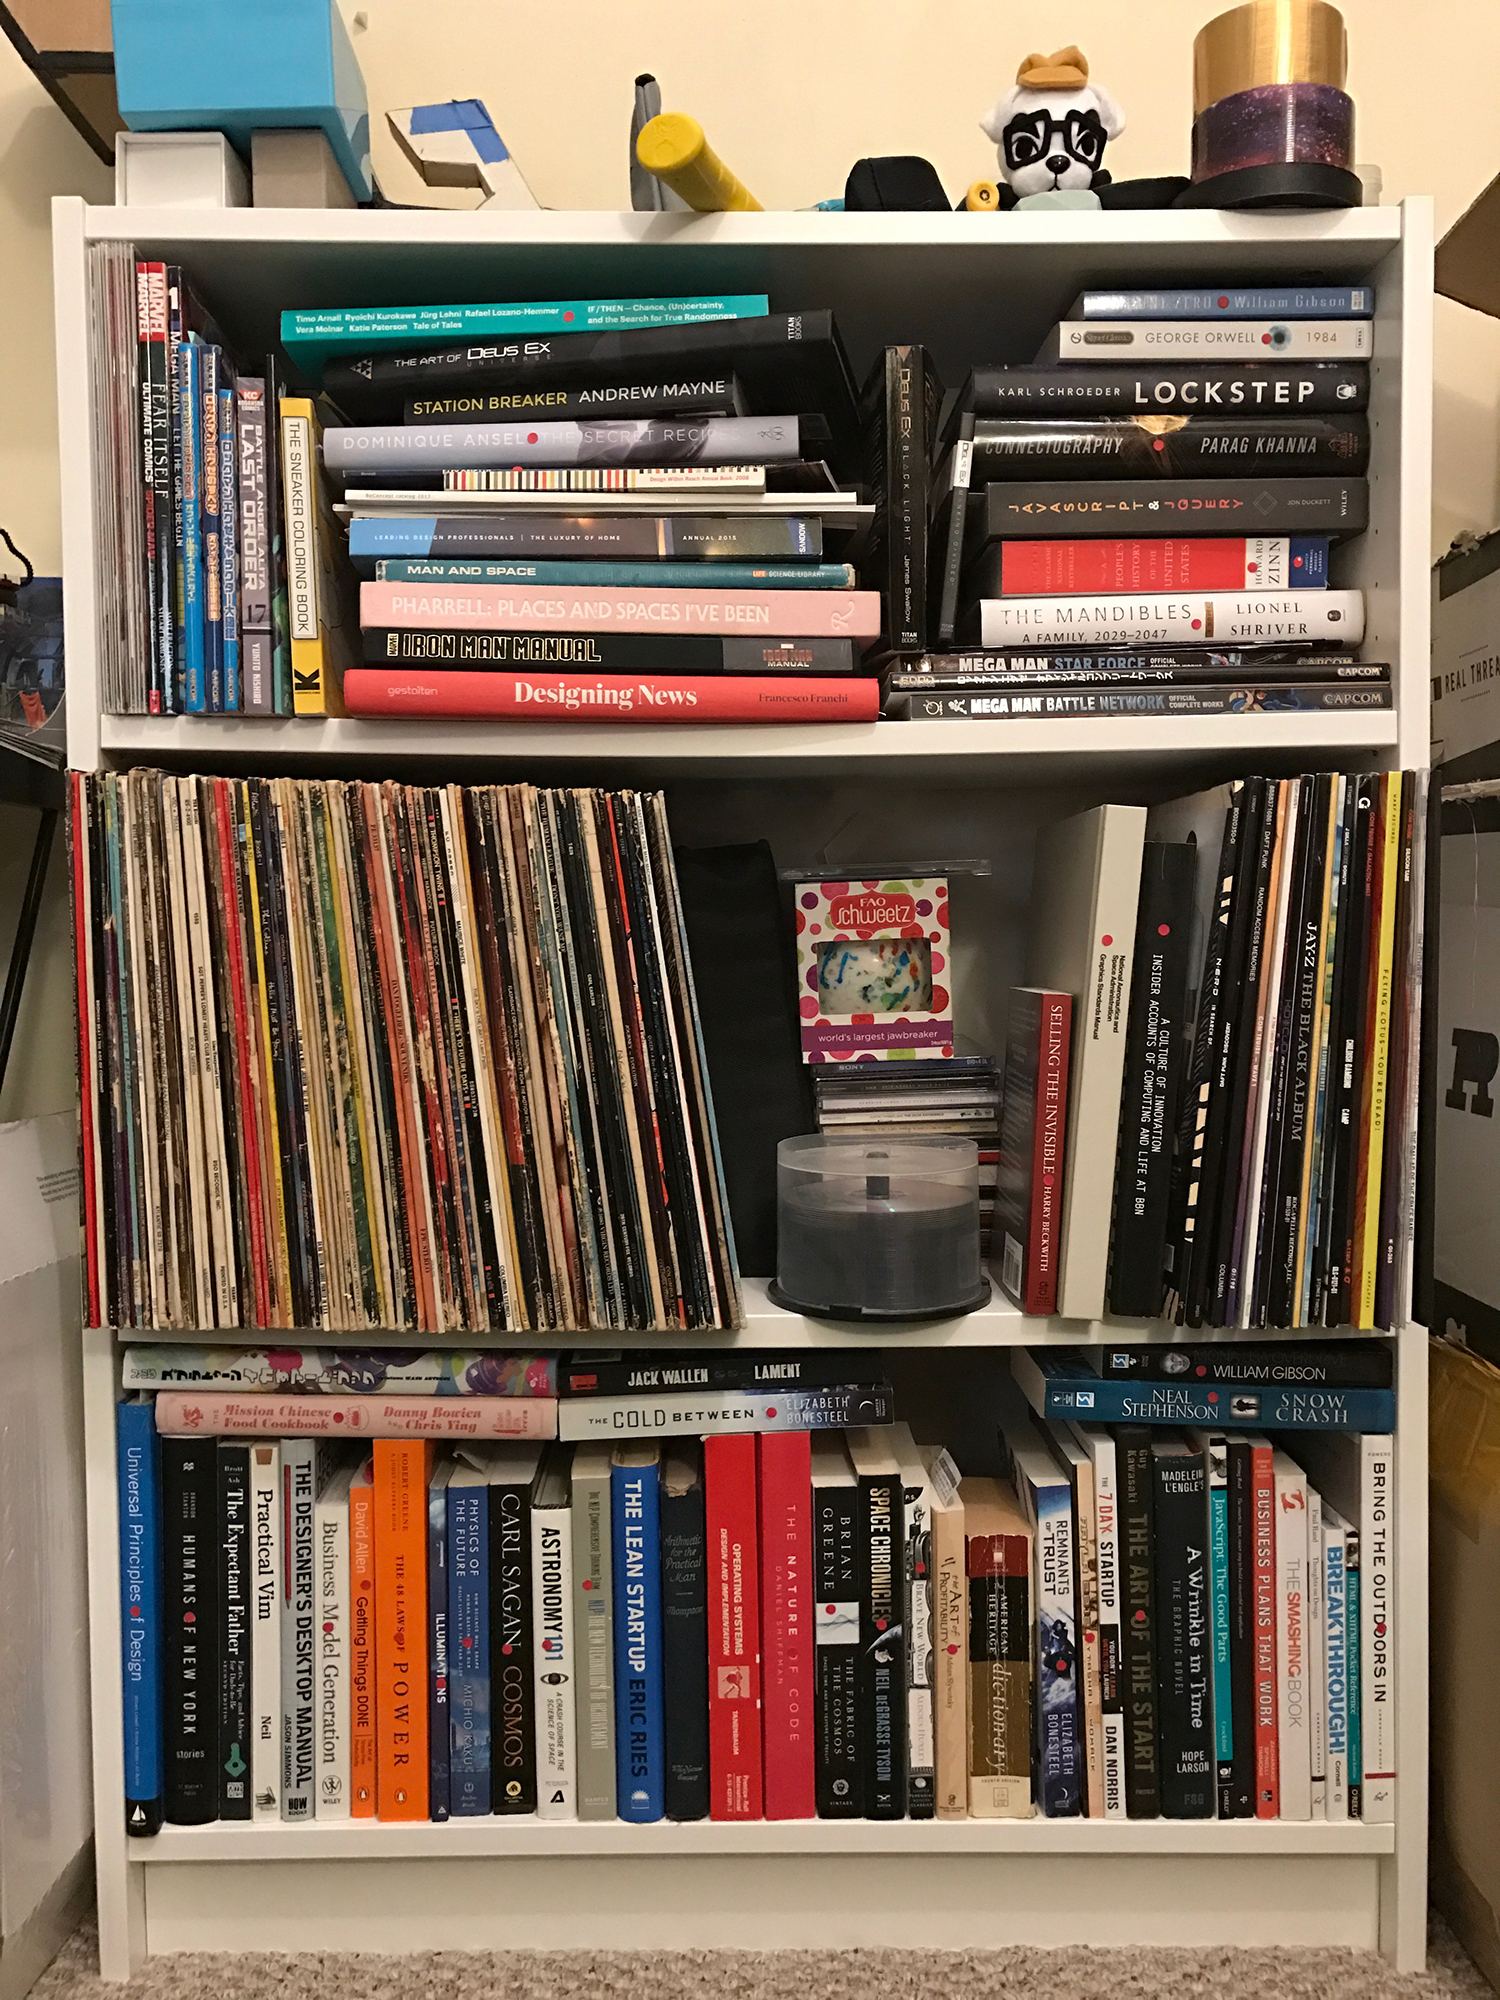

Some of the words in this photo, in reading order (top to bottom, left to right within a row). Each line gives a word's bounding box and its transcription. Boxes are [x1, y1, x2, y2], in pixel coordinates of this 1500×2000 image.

[296, 315, 315, 323] Timo
[318, 314, 341, 322] Arnall
[345, 313, 374, 322] Ryoichi
[376, 312, 416, 320] Kurokawa
[442, 310, 461, 318] Lehni
[465, 309, 490, 317] Rafael
[492, 307, 559, 317] Lozano-Hemmer
[395, 358, 418, 367] THE
[422, 356, 443, 365] ART
[447, 355, 461, 363] OF
[524, 342, 550, 356] EX
[1146, 332, 1199, 344] GEORGE
[1206, 332, 1255, 343] ORWELL
[1306, 332, 1337, 343] 1984
[413, 396, 481, 414] STATION
[489, 393, 567, 411] BREAKER
[579, 385, 656, 403] ANDREW
[663, 381, 725, 397] MAYNE
[998, 388, 1031, 397] KARL
[1039, 387, 1120, 397] SCHROEDER
[1135, 382, 1315, 403] LOCKSTEP
[289, 422, 300, 448] THE
[344, 434, 452, 449] DOMINIQUE
[464, 433, 524, 446] ANSEL
[1201, 438, 1252, 454] PARAG
[1256, 437, 1316, 454] KHANNA
[290, 452, 304, 516] SNEAKER
[293, 521, 307, 589] COLORING
[1269, 540, 1281, 584] ZINN
[297, 595, 308, 632] BOOK
[392, 597, 491, 617] PHARRELL:
[498, 601, 565, 617] PLACES
[571, 603, 611, 619] AND
[616, 603, 680, 620] SPACES
[685, 604, 719, 621] I'VE
[725, 606, 769, 622] BEEN
[1001, 610, 1042, 625] THE
[1056, 604, 1191, 623] MANDIBLES
[1236, 603, 1302, 614] LIONEL
[1231, 623, 1307, 636] SHRIVER
[403, 634, 455, 656] IRON
[461, 636, 506, 658] MAN
[513, 637, 602, 662] MANUAL
[388, 686, 437, 696] gestalten
[514, 681, 634, 712] Designing
[638, 685, 697, 706] News
[759, 693, 807, 703] Francesco
[811, 693, 847, 703] Franchi
[970, 698, 1009, 714] MEGA
[1012, 697, 1041, 712] MAN
[1047, 696, 1095, 711] BATTLE
[1100, 695, 1164, 710] NETWORK
[429, 829, 441, 869] THOMPSON
[434, 871, 443, 891] TWINS
[1255, 887, 1264, 915] RANDOM
[1252, 918, 1261, 944] ACCESS
[1304, 922, 1317, 967] JAY-Z
[1098, 954, 1106, 982] Graphics
[1151, 954, 1162, 996] INSIDER
[1249, 946, 1258, 981] MEMORIES
[1095, 984, 1103, 1015] Standards
[1301, 972, 1314, 1008] THE
[818, 1033, 851, 1042] world's
[853, 1032, 885, 1042] largest
[887, 1030, 938, 1041] jawbreaker
[1048, 1005, 1062, 1066] SELLING
[1146, 1000, 1160, 1046] ACCOUNTS
[1146, 1052, 1155, 1065] OF
[1297, 1014, 1311, 1072] BLACK
[1046, 1070, 1060, 1100] THE
[1141, 1070, 1154, 1122] COMPUTING
[1291, 1077, 1306, 1141] ALBUM
[1042, 1104, 1057, 1174] INVISIBLE
[1139, 1128, 1150, 1146] AND
[1137, 1151, 1147, 1174] LIFE
[1137, 1179, 1146, 1191] AT
[1134, 1197, 1144, 1215] BBN
[1217, 1264, 1226, 1298] COLUMBIA
[628, 1372, 659, 1386] JACK
[664, 1369, 708, 1384] WALLEN
[755, 1364, 801, 1379] LAMENT
[1213, 1365, 1269, 1378] WILLIAM
[1273, 1366, 1326, 1380] GIBSON
[224, 1406, 277, 1418] Mission
[280, 1407, 331, 1419] Chinese
[1122, 1398, 1218, 1419] STEPHENSON
[1153, 1389, 1191, 1403] NEAL
[1281, 1393, 1345, 1408] SNOW
[224, 1418, 252, 1429] Food
[256, 1418, 329, 1430] Cookbook
[614, 1409, 665, 1428] COLD
[673, 1409, 754, 1422] BETWEEN
[1275, 1409, 1348, 1424] CRASH
[296, 1461, 311, 1497] THE
[227, 1489, 243, 1519] The
[625, 1480, 642, 1518] THE
[870, 1488, 890, 1532] SPACE
[258, 1490, 273, 1579] Practical
[501, 1494, 521, 1559] CARL
[1099, 1506, 1113, 1534] DAY
[1213, 1498, 1225, 1562] JavaScript:
[1257, 1489, 1270, 1567] BUSINESS
[223, 1524, 244, 1599] Expectant
[296, 1502, 312, 1611] DESIGNER'S
[323, 1522, 338, 1596] Business
[625, 1526, 644, 1577] LEAN
[823, 1508, 833, 1589] GREENE
[840, 1517, 851, 1580] BRIAN
[1187, 1547, 1201, 1563] A
[183, 1535, 196, 1604] HUMANS
[732, 1544, 741, 1603] OPERATING
[870, 1536, 892, 1623] CHRONICLES
[1101, 1542, 1114, 1607] STARTUP
[1216, 1566, 1226, 1589] The
[1287, 1558, 1300, 1590] THE
[258, 1583, 273, 1619] Vim
[501, 1565, 522, 1651] SAGAN
[1188, 1567, 1205, 1647] Wrinkle
[1217, 1594, 1227, 1627] Good
[1258, 1575, 1270, 1626] PLANS
[227, 1605, 245, 1655] Father
[322, 1604, 341, 1658] Mdel
[626, 1584, 647, 1672] STARTUP
[733, 1606, 744, 1655] SYSTEMS
[1287, 1592, 1301, 1679] SMASHING
[183, 1646, 196, 1679] NEW
[295, 1617, 313, 1701] DESKTOP
[1190, 1655, 1203, 1672] in
[1217, 1633, 1228, 1662] Parts
[1259, 1635, 1271, 1673] THAT
[1326, 1547, 1344, 1755] BREAKTHROUGH!
[183, 1692, 196, 1734] YORK
[322, 1665, 340, 1763] Generation
[394, 1663, 409, 1766] POWER
[503, 1666, 523, 1767] COSMOS
[1191, 1677, 1206, 1728] Time
[1260, 1681, 1272, 1727] WORK
[1288, 1680, 1301, 1727] BOOK
[296, 1707, 312, 1788] MANUAL
